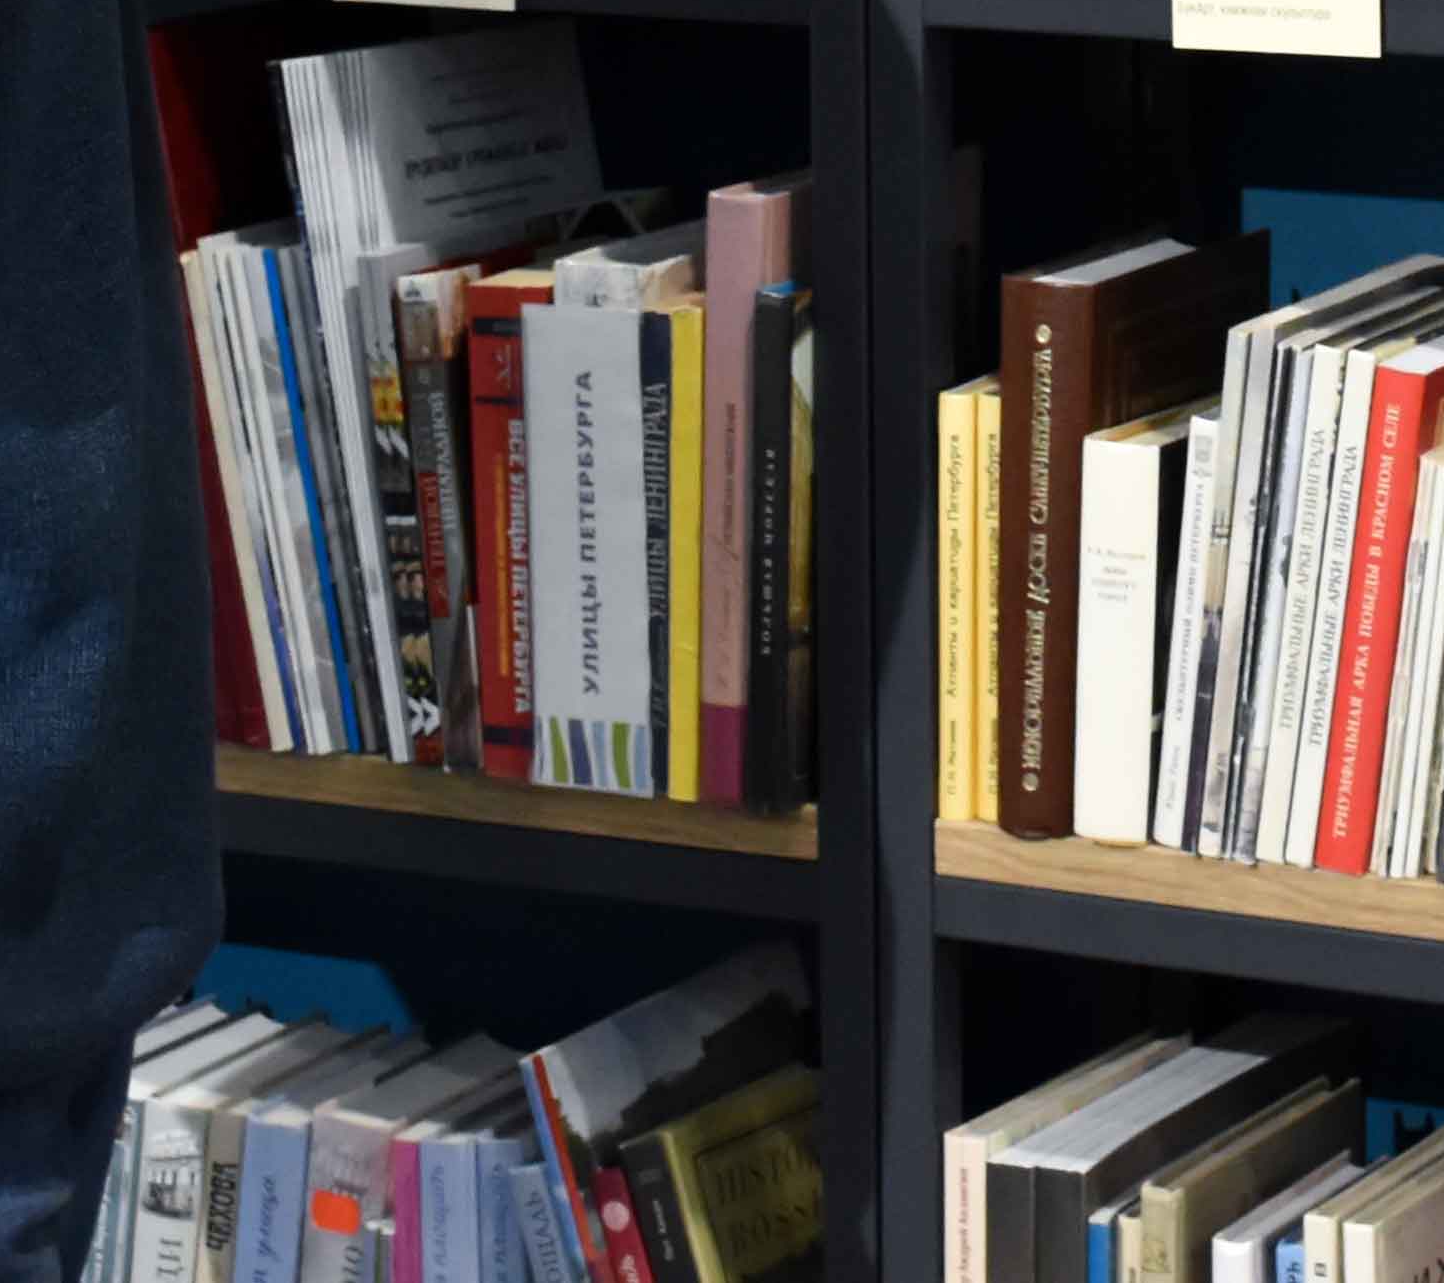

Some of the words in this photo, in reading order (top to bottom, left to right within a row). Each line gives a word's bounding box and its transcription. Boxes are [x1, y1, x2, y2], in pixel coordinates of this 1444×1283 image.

[576, 371, 598, 563] ПЕТЕРБУРГА
[1380, 404, 1402, 449] СЕЛЕ
[1301, 429, 1328, 538] ЛЕНИНГРАДА
[1329, 446, 1359, 554] ЛЕНИНГРАДА
[1367, 456, 1396, 539] КРАСНОМ
[1294, 546, 1316, 587] АРКИ
[1324, 561, 1346, 605] АРКИ
[1355, 565, 1382, 637] ПОБЕДЫ
[581, 572, 603, 695] УЛИЦЫ
[1278, 592, 1310, 729] ТРИУМФАЛЬНЫЕ
[1308, 611, 1339, 746] ТРИУМФАЛЬНЫЕ
[1350, 644, 1371, 688] АРКА
[1332, 697, 1365, 838] ТРИУМФАЛЬНАЯ
